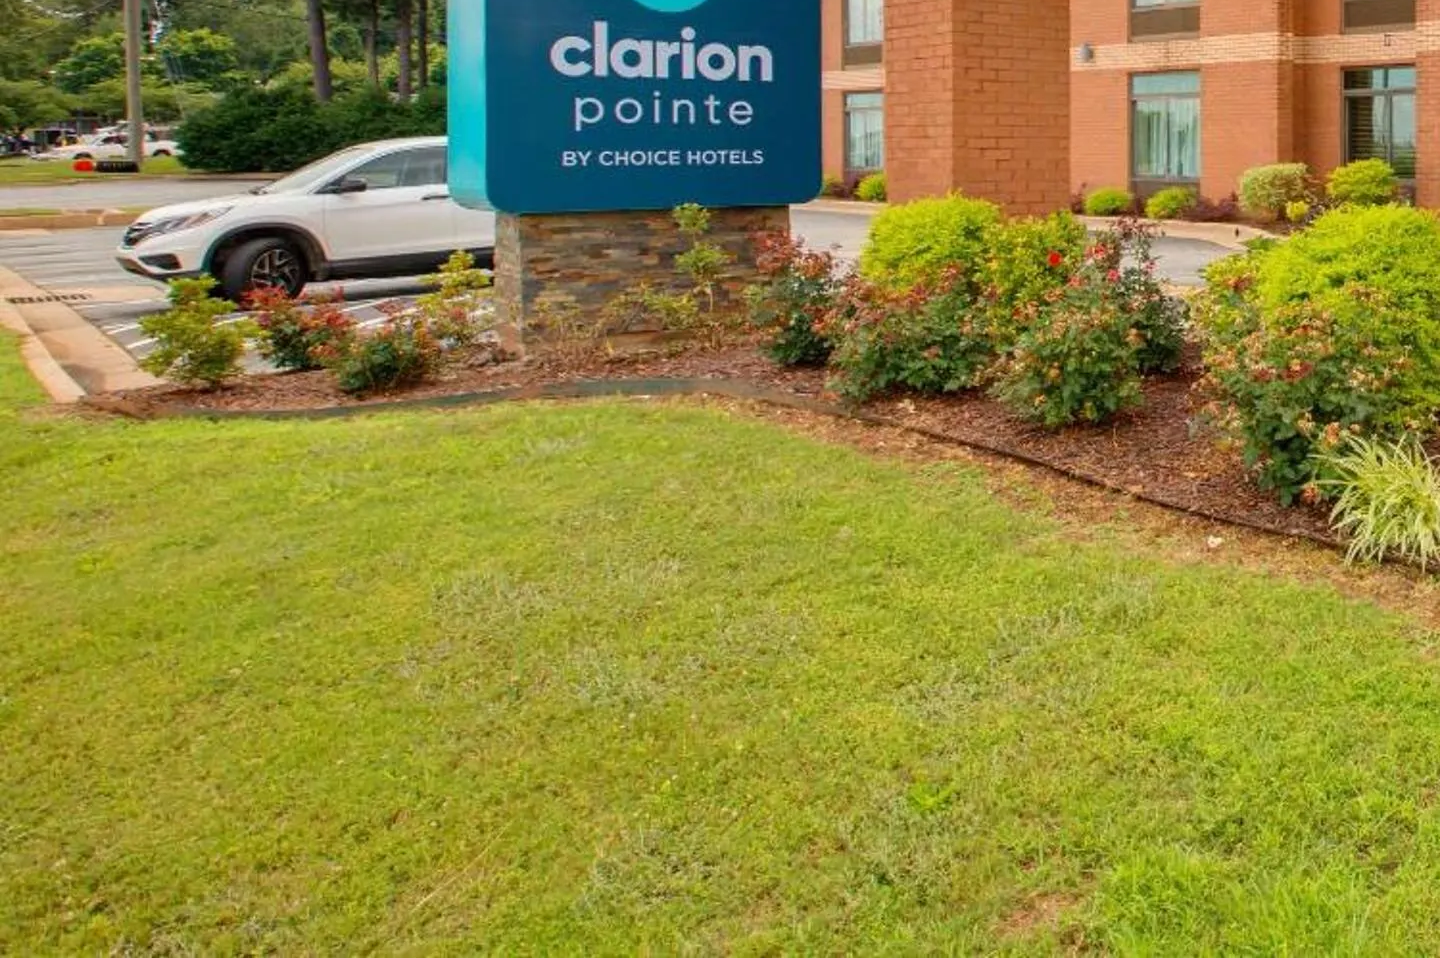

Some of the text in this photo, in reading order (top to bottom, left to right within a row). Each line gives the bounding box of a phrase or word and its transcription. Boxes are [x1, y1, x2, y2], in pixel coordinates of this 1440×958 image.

[550, 21, 773, 81] clarion
[575, 91, 754, 131] pointe
[562, 149, 765, 167] BY CHOICE HOTELS
